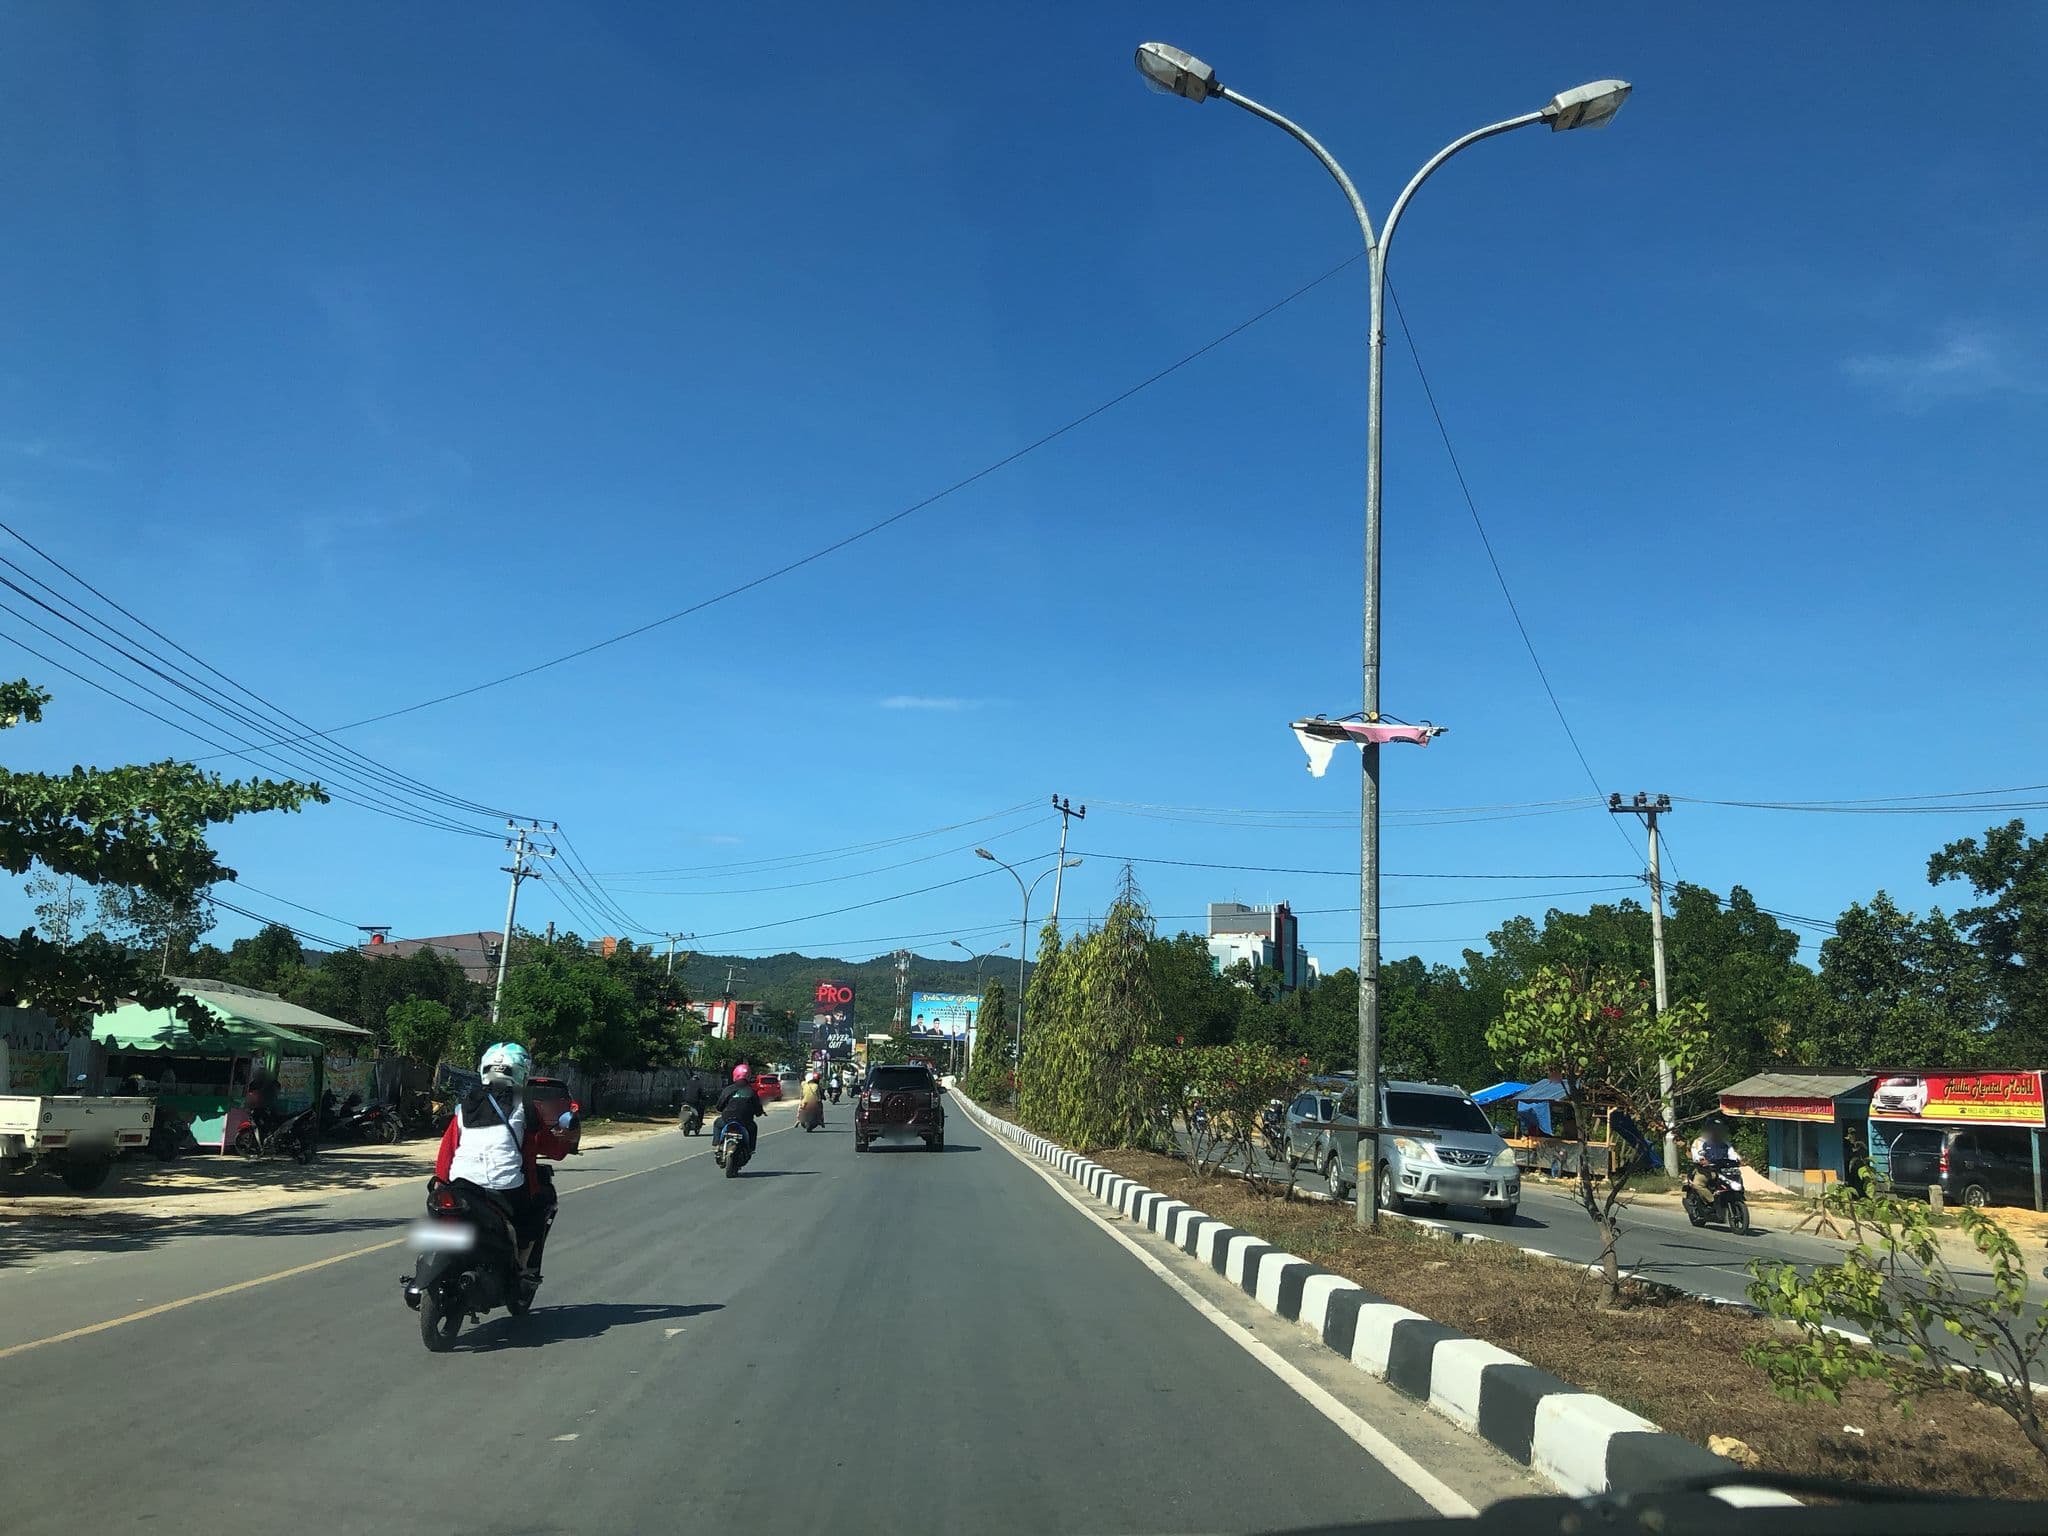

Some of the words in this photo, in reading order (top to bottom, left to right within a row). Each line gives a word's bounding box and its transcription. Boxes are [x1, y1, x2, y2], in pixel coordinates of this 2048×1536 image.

[818, 987, 852, 1003] PRO
[826, 1033, 850, 1042] NEVER
[828, 1041, 843, 1049] QUIT
[1971, 1077, 2003, 1098] Rental
[2004, 1075, 2035, 1099] Mobil
